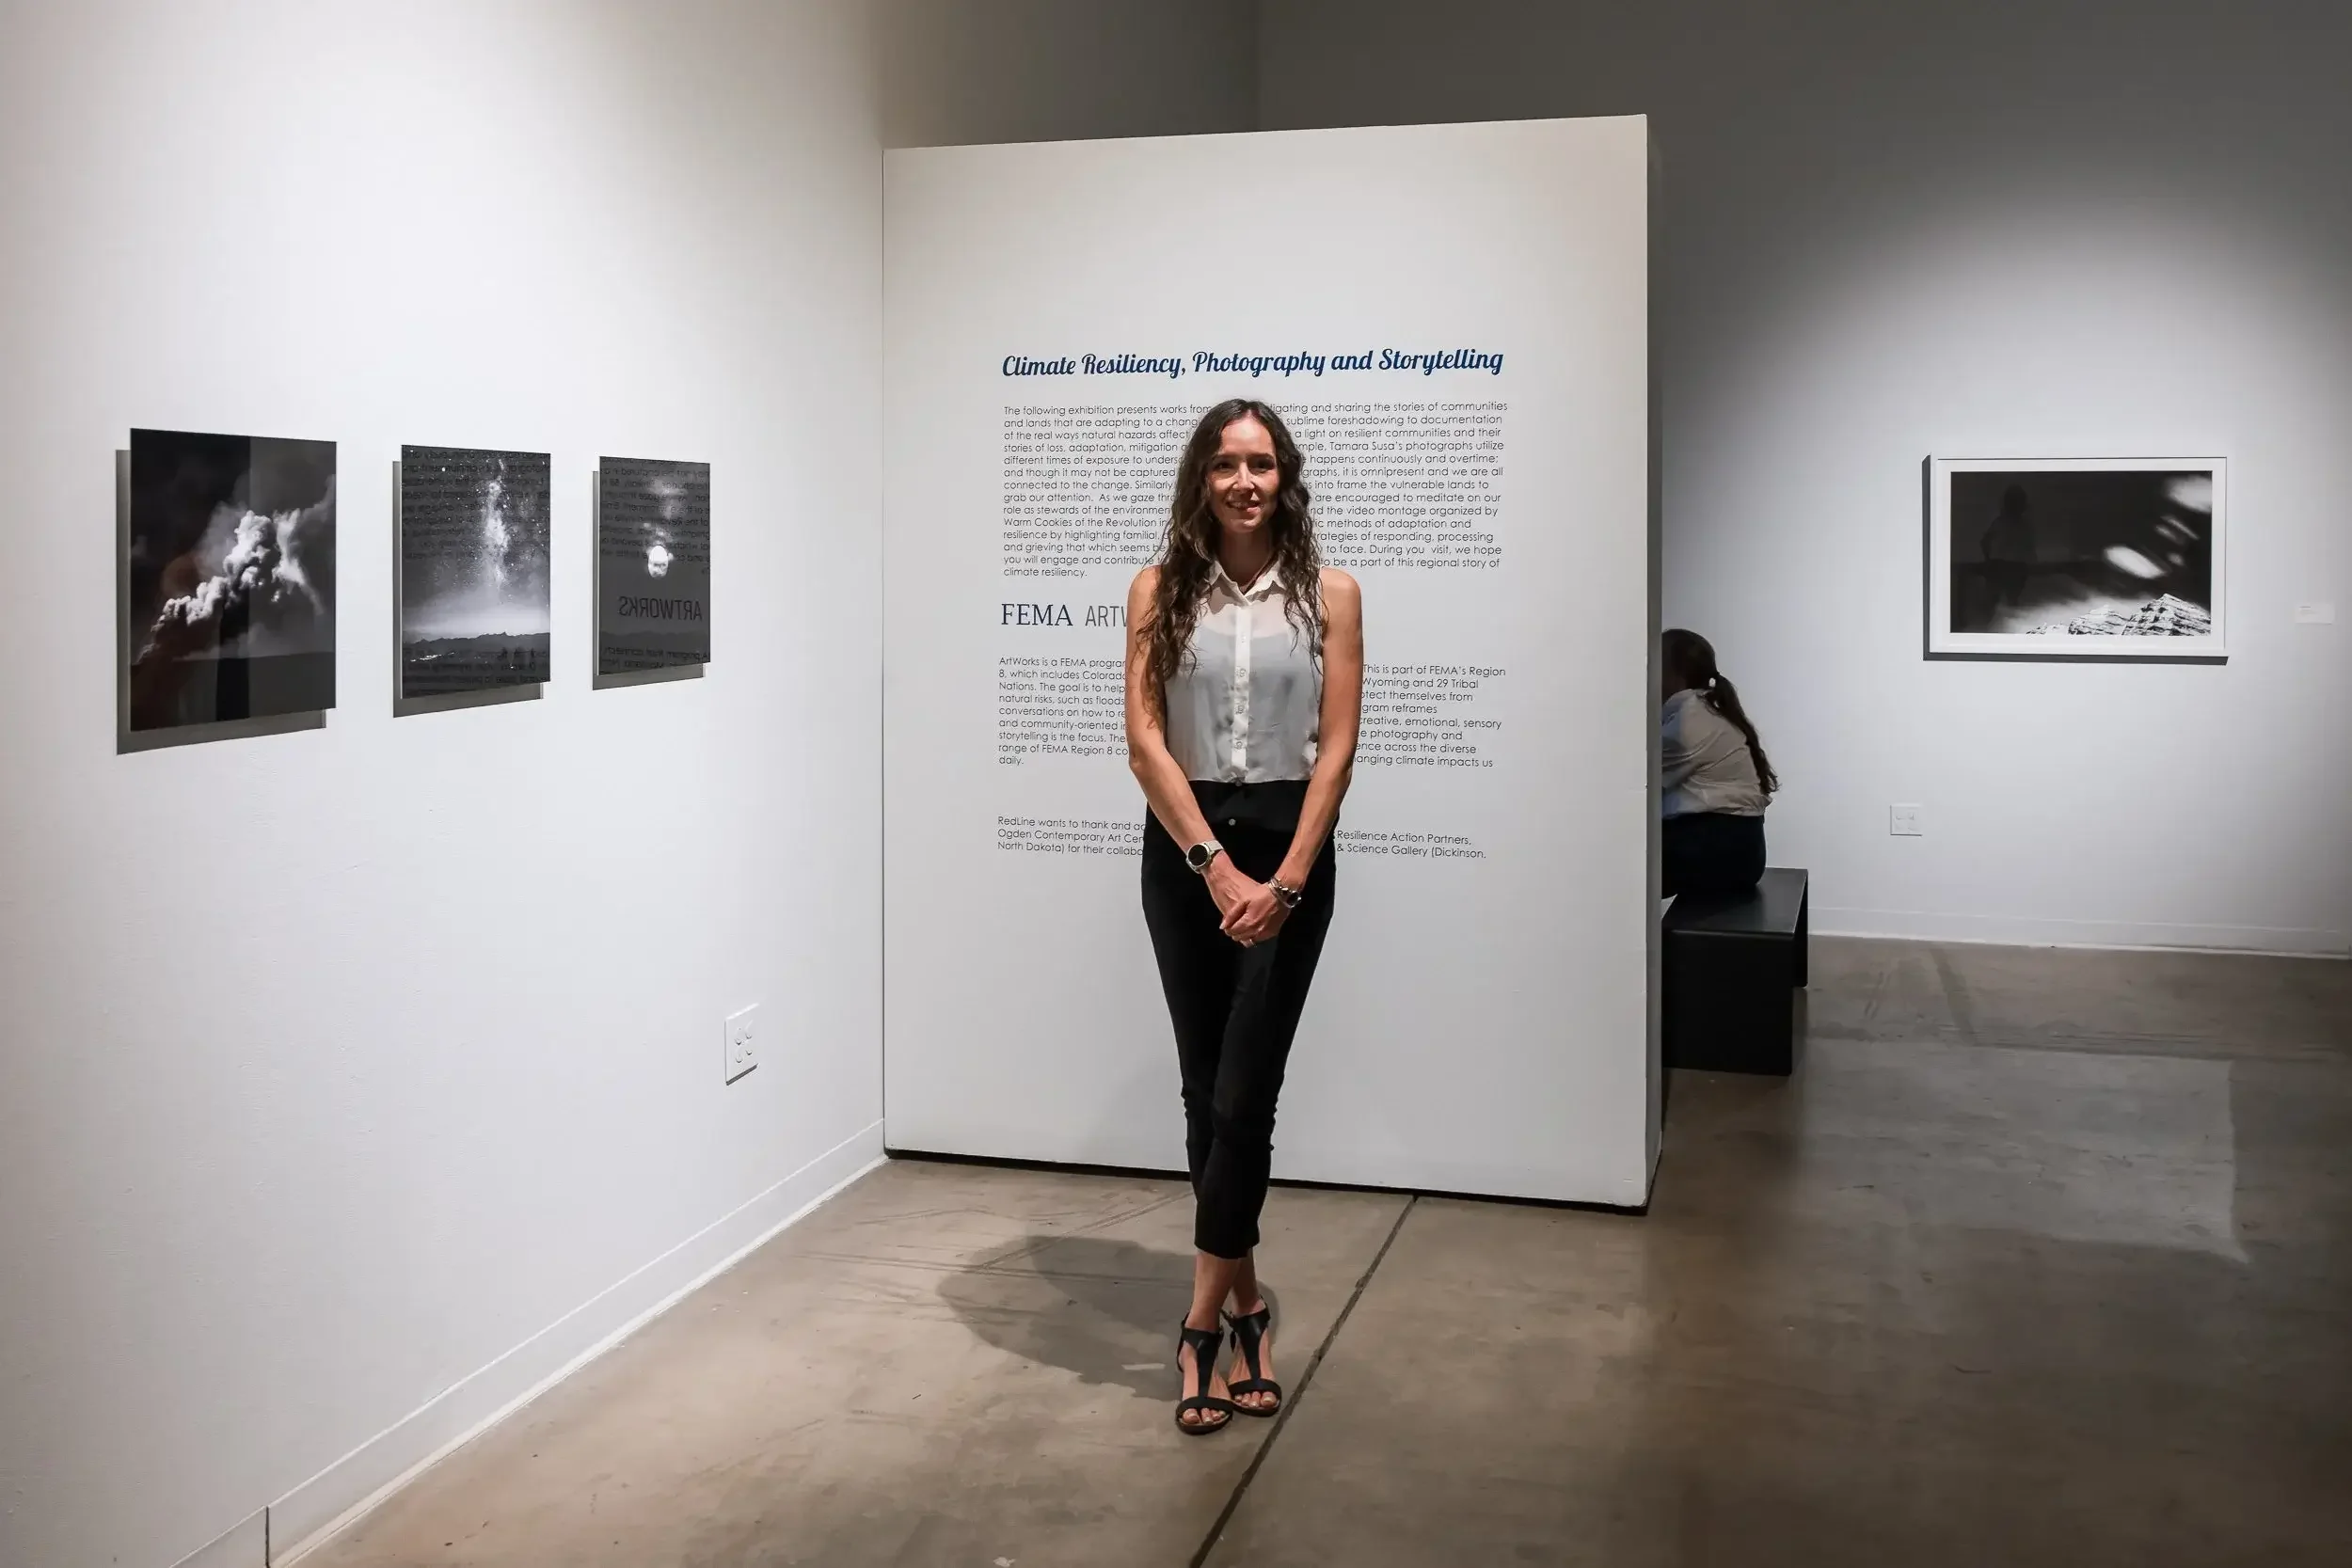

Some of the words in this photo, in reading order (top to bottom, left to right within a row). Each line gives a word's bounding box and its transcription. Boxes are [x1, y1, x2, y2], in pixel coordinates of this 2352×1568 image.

[1002, 355, 1076, 376] Climate
[1081, 353, 1186, 379] Resiliency,
[1192, 350, 1326, 377] Photography
[1330, 350, 1373, 370] and
[1378, 348, 1503, 375] Storytelling
[1004, 406, 1020, 414] The
[1023, 405, 1065, 417] following
[1068, 405, 1114, 414] exhibition
[1116, 405, 1157, 416] presents
[1159, 405, 1186, 413] works
[1334, 403, 1370, 414] sharing
[1393, 402, 1425, 411] stories
[1440, 401, 1507, 410] communities
[1025, 418, 1051, 427] lands
[1053, 418, 1073, 426] that
[1094, 418, 1140, 429] adapting
[1286, 416, 1324, 425] sublime
[1327, 416, 1404, 427] foreshadowing
[1419, 415, 1501, 424] documentation
[1034, 431, 1052, 439] real
[1054, 433, 1079, 442] ways
[1081, 430, 1115, 439] natural
[1118, 430, 1156, 439] hazards
[1304, 429, 1325, 440] light
[1344, 429, 1382, 437] resilient
[1384, 428, 1450, 437] communities
[1478, 428, 1501, 436] their
[1004, 443, 1032, 452] stories
[1129, 443, 1177, 454] mitigation
[1329, 442, 1368, 450] Tamara
[1405, 441, 1473, 452] photographs
[1475, 441, 1504, 450] utilize
[1003, 456, 1043, 464] different
[1046, 456, 1071, 464] times
[1085, 458, 1129, 467] exposure
[1309, 455, 1355, 466] happens
[1357, 454, 1422, 465] continuously
[1025, 468, 1059, 479] though
[1070, 470, 1091, 479] may
[1094, 468, 1110, 476] not
[1360, 467, 1424, 478] omnipresent
[1490, 467, 1502, 475] all
[1003, 480, 1057, 489] connected
[1090, 480, 1132, 491] change.
[1314, 480, 1333, 489] into
[1336, 480, 1367, 489] frame
[1390, 480, 1445, 488] vulnerable
[1447, 480, 1475, 488] lands
[1003, 493, 1027, 504] grab
[1130, 495, 1154, 504] gaze
[1334, 493, 1399, 504] encouraged
[1416, 493, 1464, 502] meditate
[1003, 505, 1021, 514] role
[1036, 505, 1079, 514] stewards
[1346, 506, 1375, 514] video
[1378, 506, 1426, 517] montage
[1429, 506, 1481, 517] organized
[1003, 518, 1031, 526] Warm
[1034, 518, 1072, 526] Cookies
[1105, 518, 1156, 526] Revolution
[1327, 519, 1371, 527] methods
[1387, 519, 1447, 530] adaptation
[1003, 530, 1047, 538] resilience
[1064, 530, 1120, 541] highlighting
[1437, 532, 1493, 543] processing
[1025, 543, 1063, 554] grieving
[1066, 543, 1085, 551] that
[1087, 543, 1117, 551] which
[1369, 545, 1402, 556] During
[1405, 547, 1424, 556] you
[1473, 545, 1501, 556] hope
[1003, 557, 1021, 566] you
[1023, 555, 1038, 563] will
[1040, 557, 1079, 566] engage
[1360, 558, 1381, 569] part
[1397, 558, 1413, 566] this
[1416, 558, 1459, 569] regional
[1462, 558, 1486, 569] story
[1003, 568, 1039, 576] climate
[1041, 568, 1087, 579] resiliency.
[1001, 603, 1073, 626] FEMA
[999, 657, 1040, 666] ArtWorks
[1060, 658, 1087, 666] FEMA
[1391, 665, 1413, 676] part
[1429, 666, 1466, 675] FEMA's
[1468, 666, 1505, 678] Region
[1009, 669, 1038, 678] which
[1040, 670, 1079, 679] includes
[1436, 679, 1448, 687] 29
[1451, 679, 1478, 688] Tribal
[1039, 682, 1056, 691] The
[1058, 683, 1080, 694] goal
[1389, 691, 1446, 700] themselves
[1449, 692, 1472, 700] from
[998, 694, 1032, 703] natural
[1057, 695, 1079, 704] such
[1391, 703, 1437, 713] reframes
[998, 706, 1064, 716] conversations
[1081, 708, 1103, 717] how
[1463, 720, 1502, 730] sensory
[1020, 719, 1117, 732] community-oriented
[1370, 729, 1438, 742] photography
[998, 731, 1048, 743] storytelling
[1077, 733, 1106, 742] focus.
[1108, 734, 1125, 742] The
[1439, 744, 1476, 753] diverse
[998, 745, 1027, 755] range
[1041, 744, 1068, 753] FEMA
[1071, 745, 1104, 757] Region
[1395, 755, 1434, 765] climate
[1437, 756, 1479, 769] impacts
[998, 755, 1023, 767] daily.
[997, 816, 1035, 826] RedLine
[1037, 818, 1066, 827] wants
[1081, 820, 1108, 829] thank
[1337, 831, 1387, 841] Resilience
[1389, 832, 1424, 842] Action
[1427, 834, 1471, 845] Partners,
[997, 828, 1031, 841] Ogden
[1034, 830, 1105, 844] Contemporary
[1107, 833, 1121, 842] Art
[1346, 844, 1388, 854] Science
[1390, 846, 1428, 858] Gallery
[997, 841, 1023, 851] North
[1026, 842, 1064, 855] Dakota)
[1067, 844, 1080, 853] for
[1083, 844, 1104, 854] their
